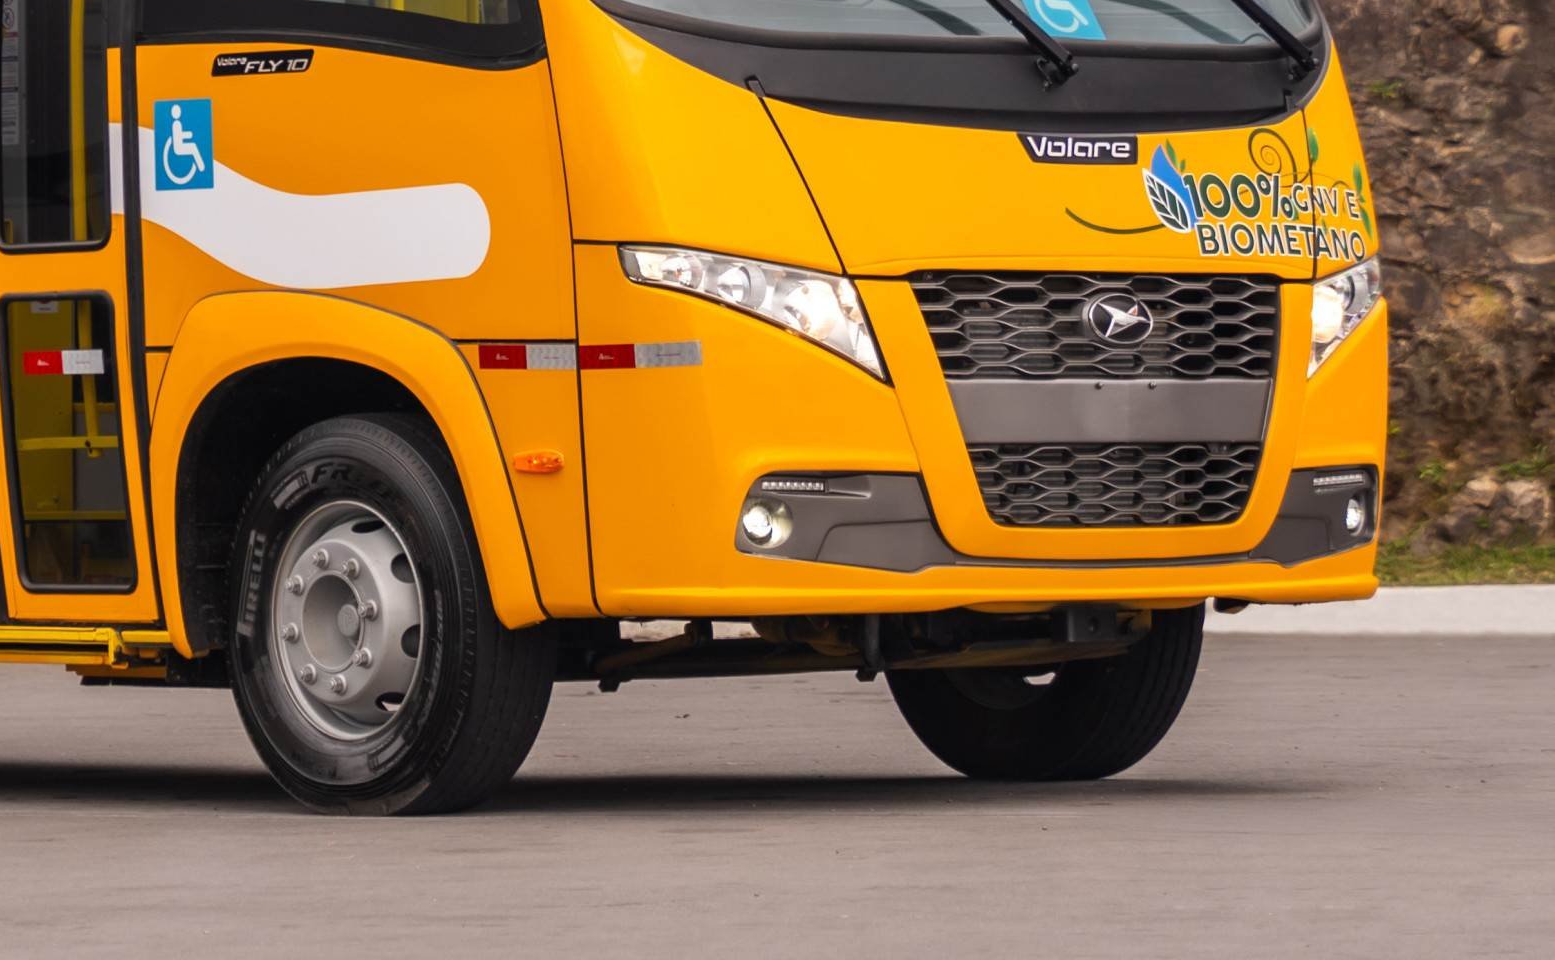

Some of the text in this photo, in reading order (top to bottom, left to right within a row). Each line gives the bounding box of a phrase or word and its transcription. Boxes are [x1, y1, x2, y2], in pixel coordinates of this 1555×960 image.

[244, 59, 284, 74] FLY
[286, 58, 309, 72] 10
[1026, 136, 1131, 158] Volare
[1183, 173, 1362, 221] 100% GNV E
[1195, 222, 1366, 263] BIOMETANO
